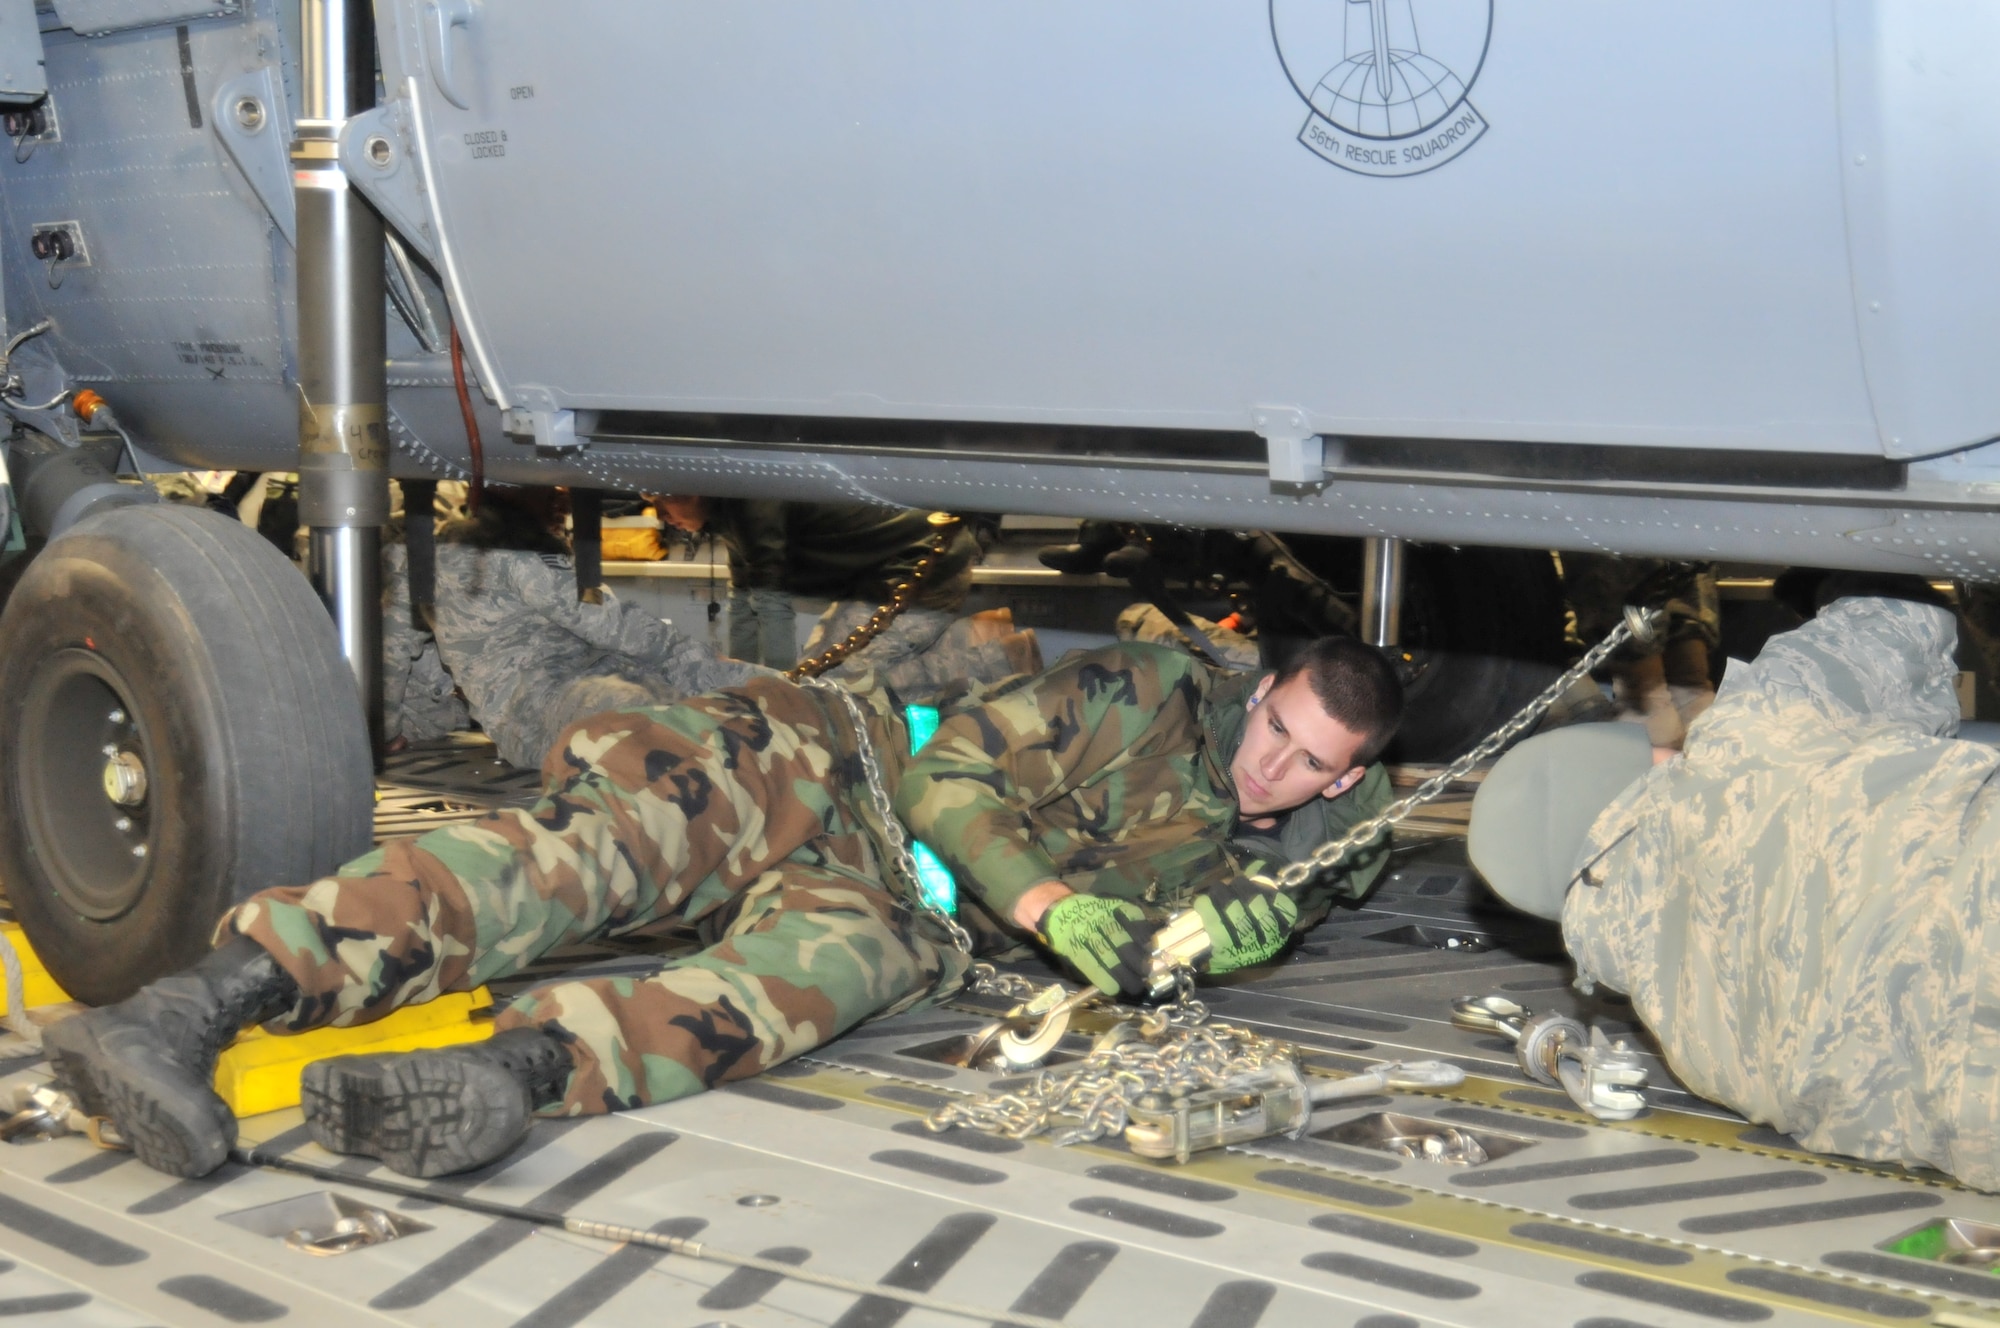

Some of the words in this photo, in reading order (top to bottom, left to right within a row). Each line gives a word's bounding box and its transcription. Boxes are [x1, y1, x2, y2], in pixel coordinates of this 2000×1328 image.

[510, 85, 534, 100] OPEN
[464, 131, 497, 145] CLOSED
[1309, 124, 1340, 154] 56th
[1345, 143, 1397, 165] RESCUE
[1402, 111, 1476, 163] SQUADRON
[472, 144, 505, 159] LOCKED
